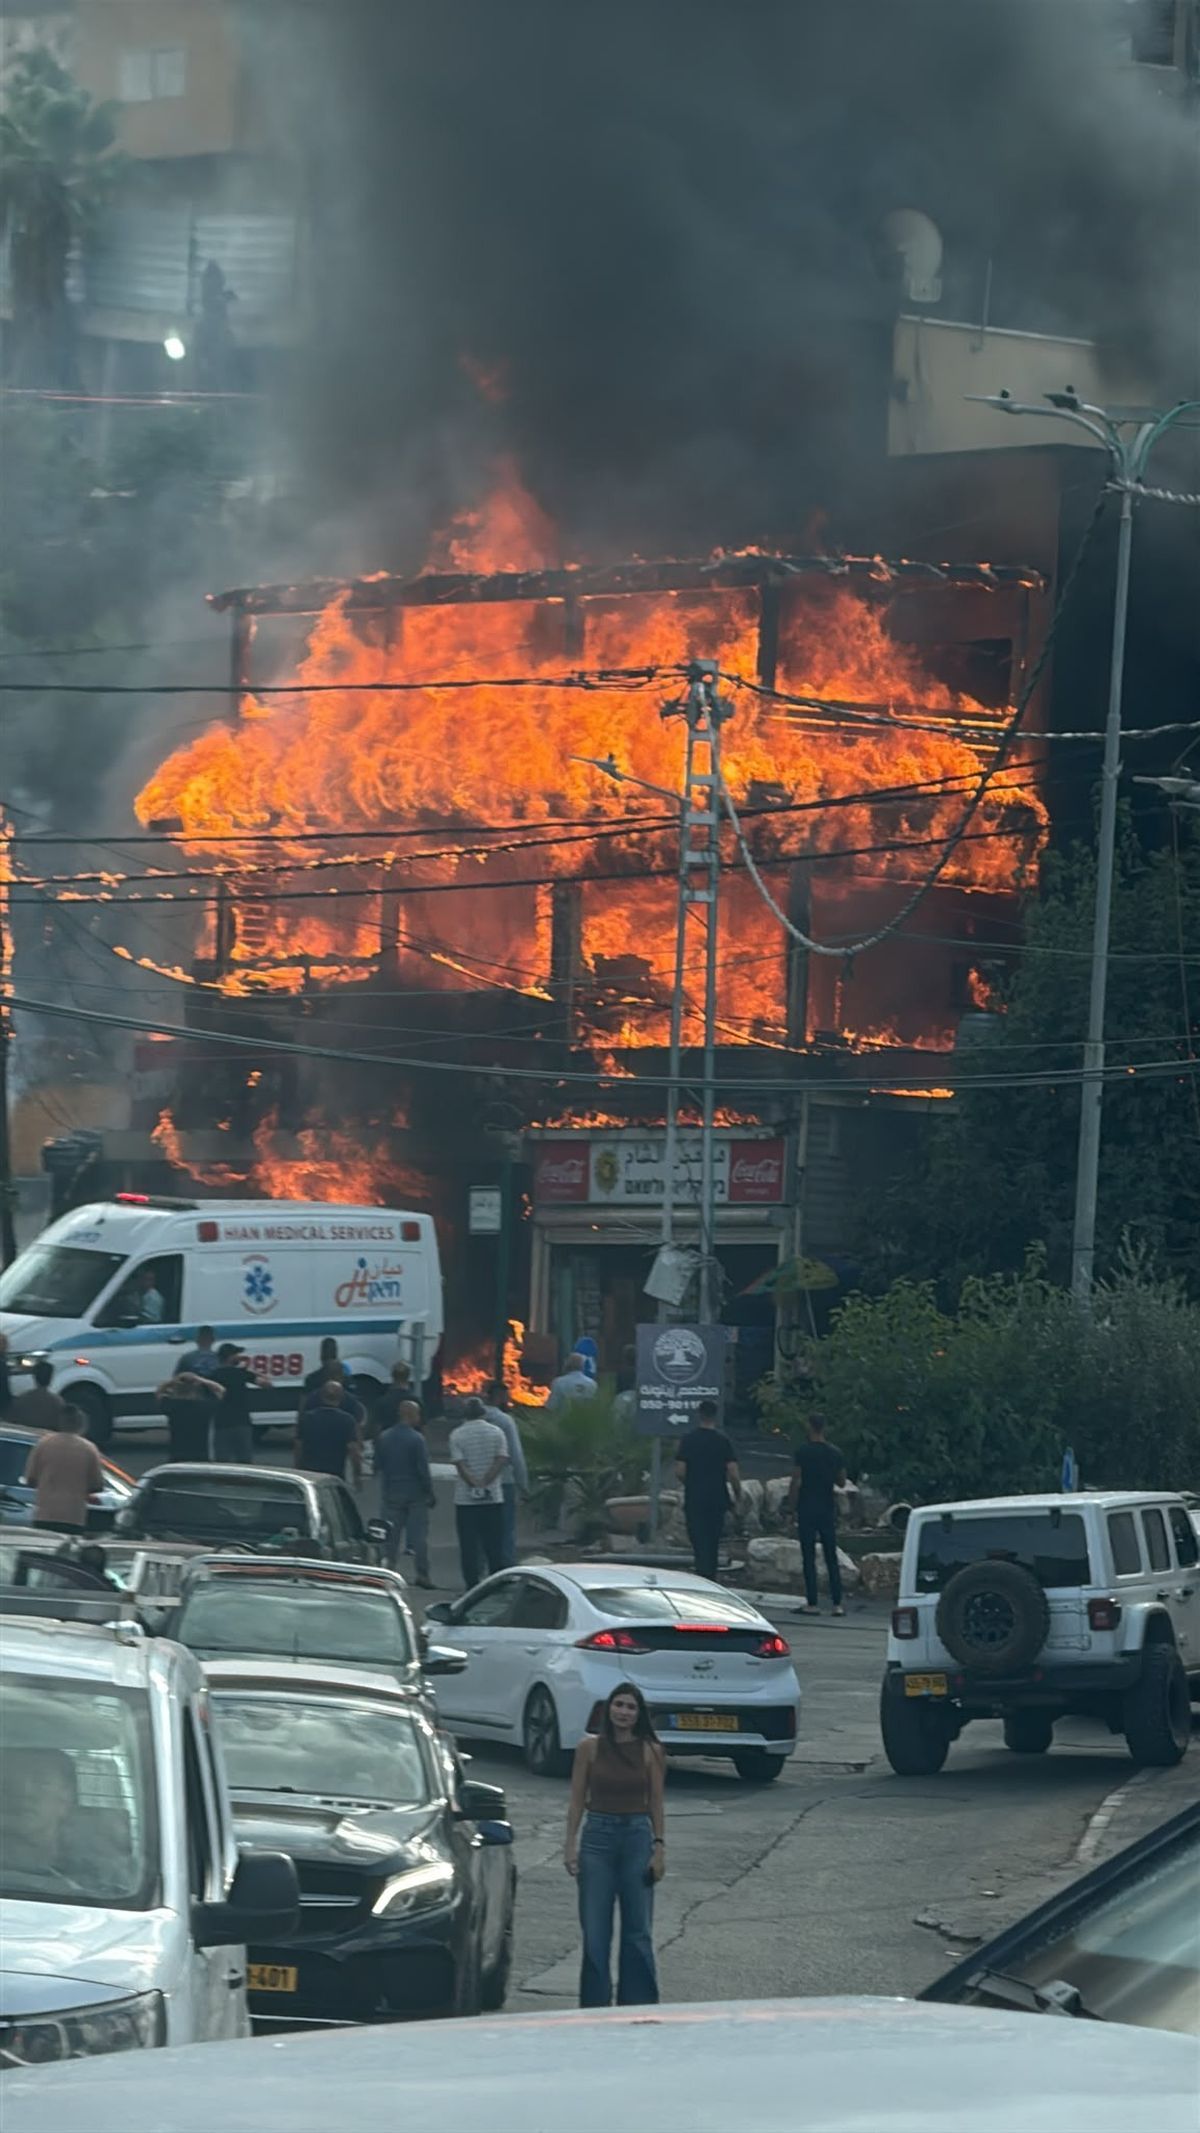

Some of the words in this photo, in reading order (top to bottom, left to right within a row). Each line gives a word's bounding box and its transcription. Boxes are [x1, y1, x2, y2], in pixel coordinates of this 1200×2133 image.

[263, 1226, 326, 1240] MEDICAL
[330, 1226, 395, 1241] SERVICES
[247, 1965, 288, 1988] -401
